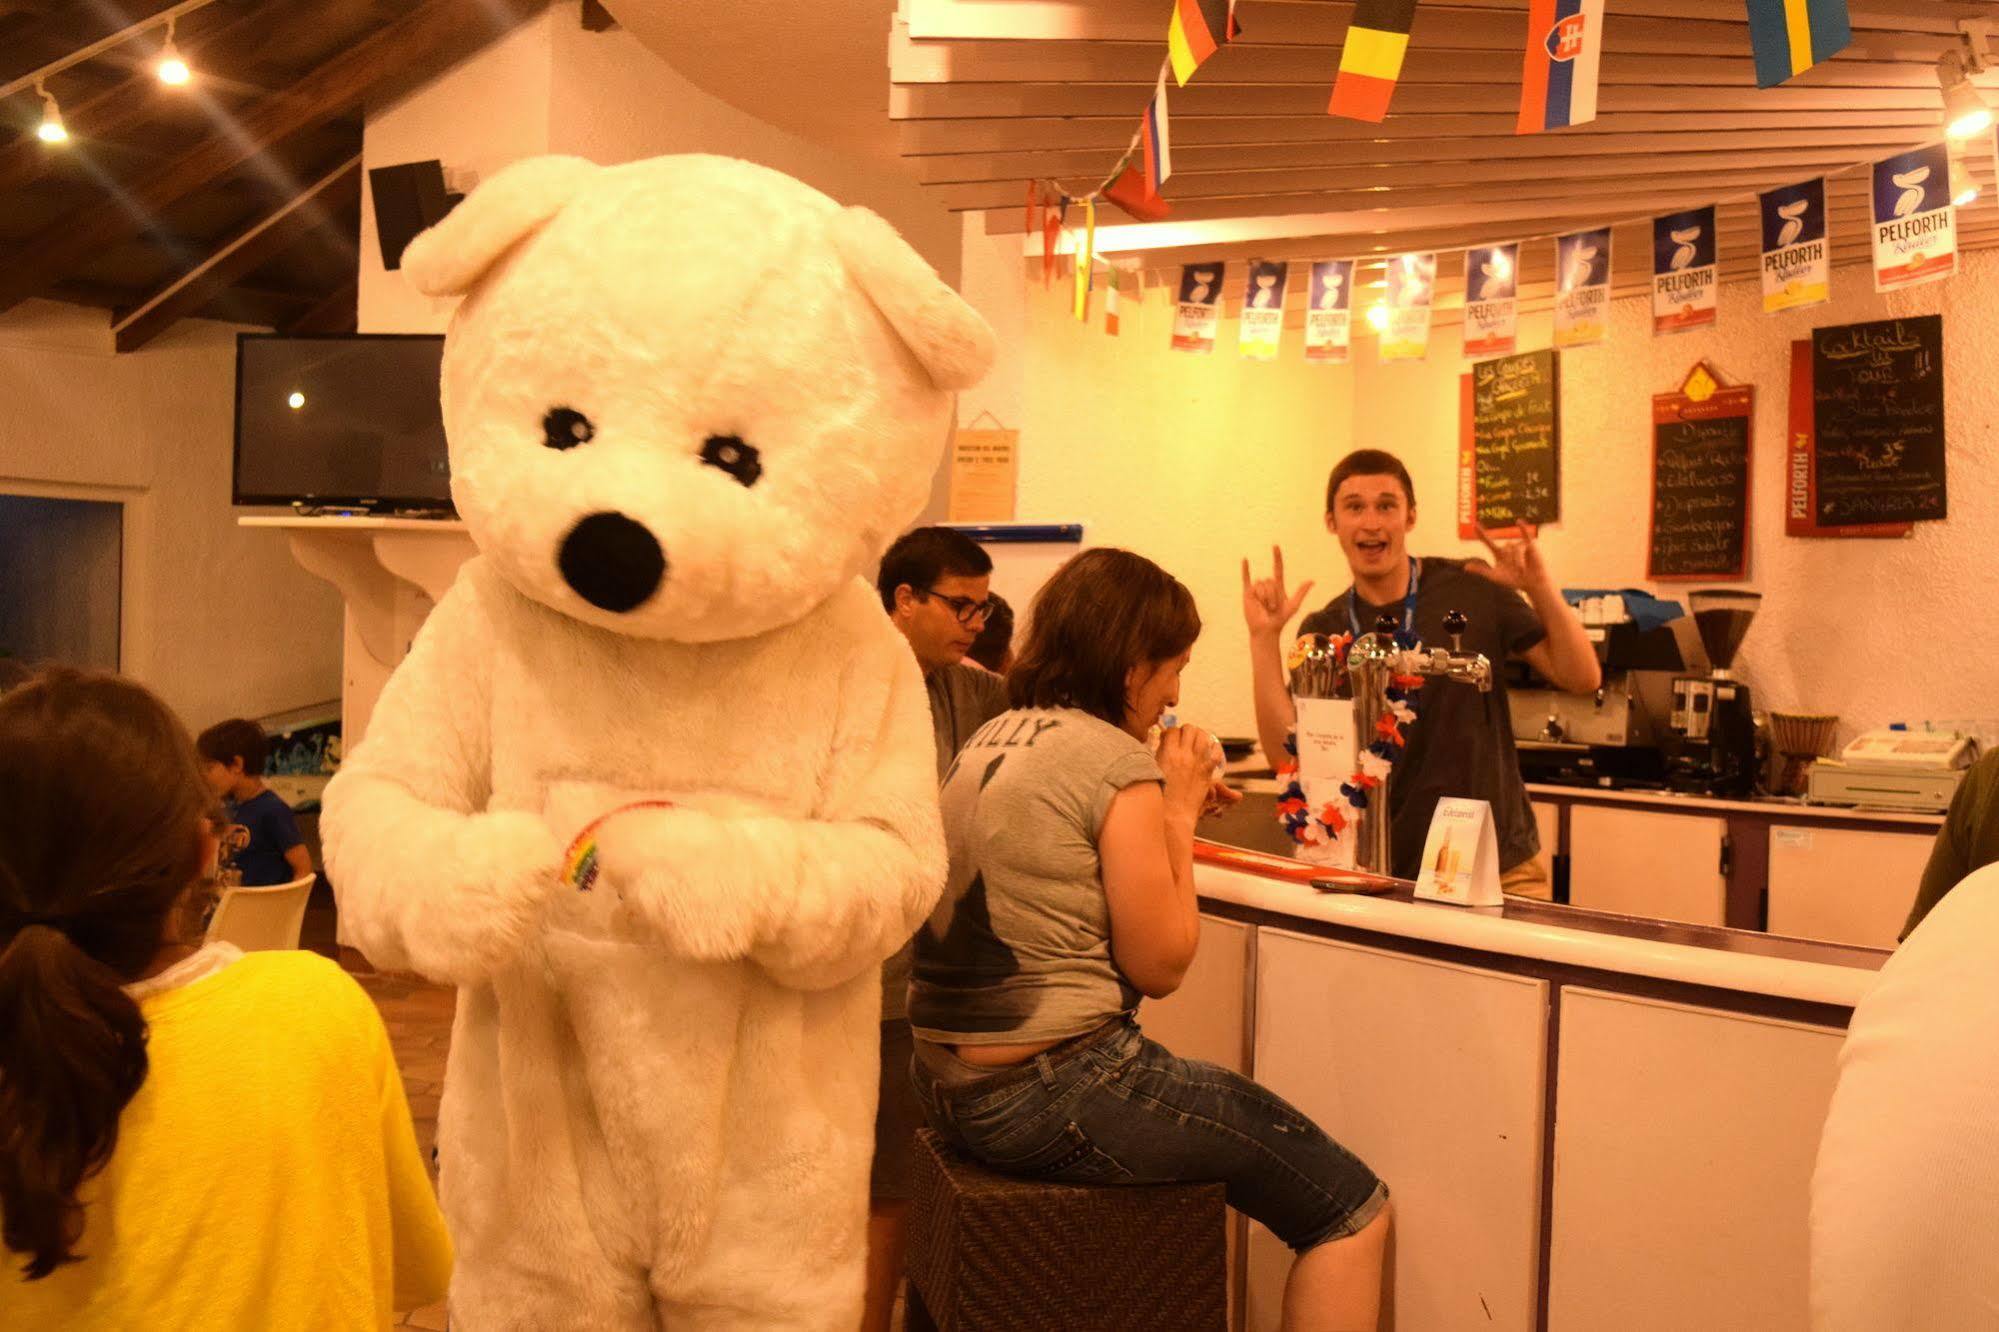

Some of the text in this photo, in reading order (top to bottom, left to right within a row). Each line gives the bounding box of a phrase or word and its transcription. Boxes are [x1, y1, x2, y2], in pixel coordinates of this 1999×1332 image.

[1880, 212, 1948, 243] PELFORTH
[1765, 243, 1822, 272] PELFORTH
[1657, 269, 1712, 293] PELFORTH
[1558, 288, 1605, 309] LFORTH
[1792, 453, 1809, 519] PELFORTH
[965, 718, 1062, 748] ILLY
